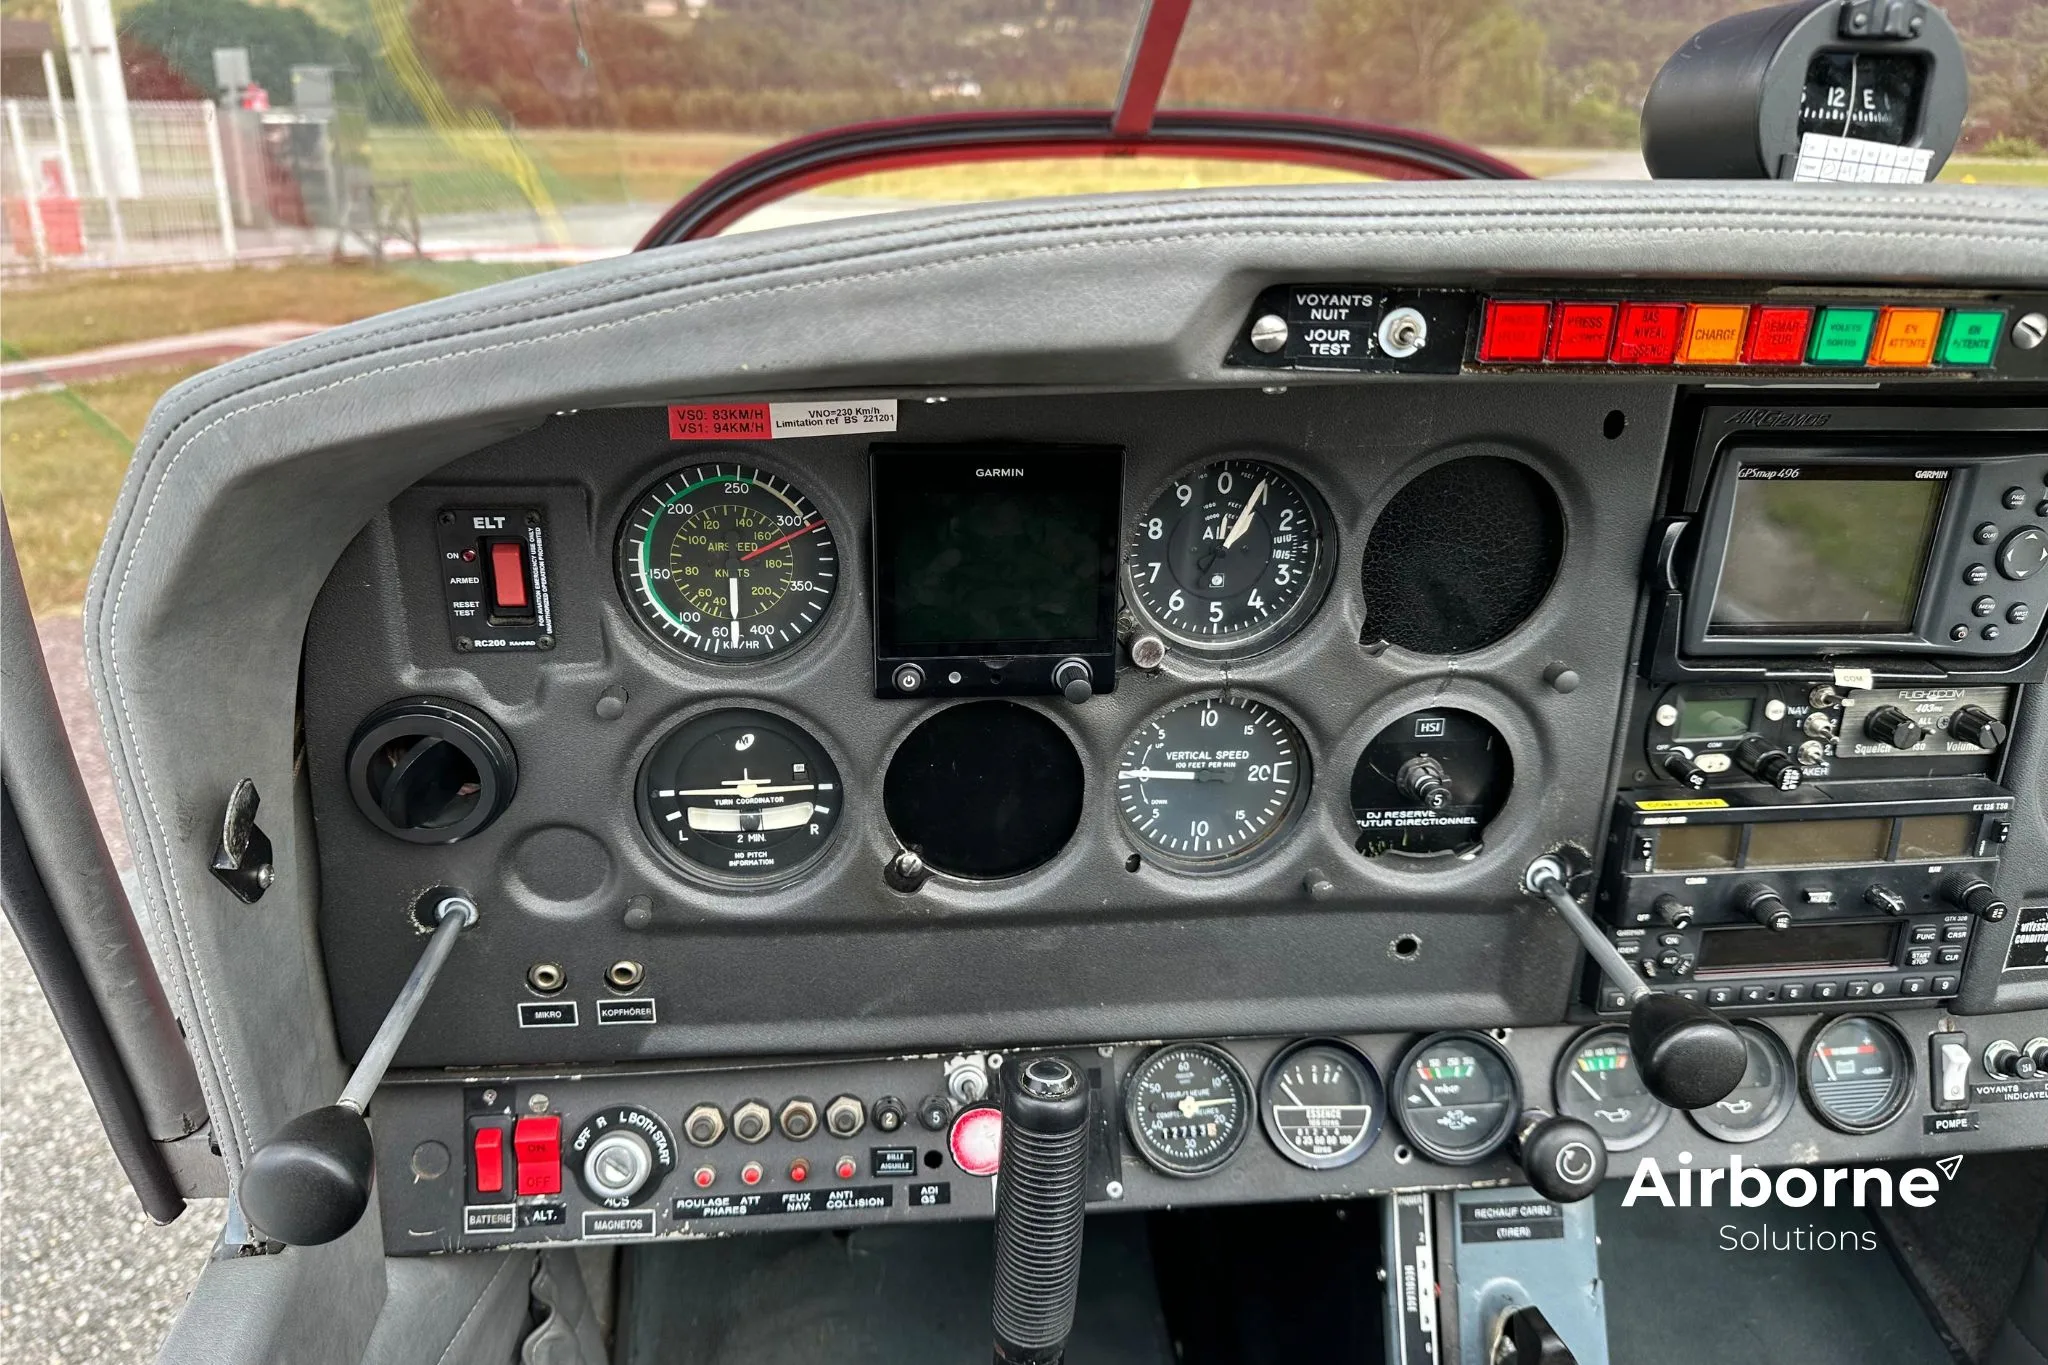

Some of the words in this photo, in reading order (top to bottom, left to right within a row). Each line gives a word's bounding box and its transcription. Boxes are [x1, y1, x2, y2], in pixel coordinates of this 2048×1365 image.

[1827, 87, 1846, 107] 12
[1863, 89, 1875, 109] E
[1296, 294, 1373, 307] VOYANTS
[1310, 309, 1350, 321] NUIT
[1304, 329, 1350, 342] JOUR
[1695, 328, 1736, 341] CHARGE
[1309, 343, 1351, 356] TEST
[712, 408, 764, 420] 83KM/H
[808, 408, 853, 419] VNO=230
[855, 406, 880, 416] Km/h
[775, 417, 823, 429] Limitation
[825, 416, 839, 426] ref
[844, 415, 858, 425] BS
[863, 413, 895, 424] 221201
[713, 421, 764, 433] 94KM/H
[975, 468, 1024, 477] GARMIN
[1738, 467, 1776, 480] GPSmap
[1777, 468, 1800, 478] 496
[1915, 470, 1949, 479] GARMIN
[724, 483, 749, 494] 250
[1217, 471, 1233, 495] 0
[1176, 484, 1193, 507] 9
[667, 503, 693, 515] 200
[1228, 501, 1243, 509] FEET
[473, 516, 505, 529] ELT
[703, 520, 720, 530] 120
[735, 518, 753, 528] 140
[776, 516, 802, 527] 300
[1279, 508, 1294, 532] 2
[1148, 518, 1163, 540] 8
[527, 527, 535, 543] ONLY
[688, 535, 707, 545] 100
[754, 532, 772, 541] 160
[529, 543, 537, 555] USE
[535, 527, 544, 561] PROHIBITED
[707, 542, 758, 552] AIRSEED
[446, 552, 459, 560] ON
[1272, 549, 1290, 560] 1015
[765, 559, 783, 569] 180
[531, 555, 541, 590] EMERGENCY
[538, 560, 548, 592] OPERATION
[649, 568, 671, 580] 150
[685, 567, 699, 576] 80
[714, 568, 750, 578] KNTS
[1148, 562, 1162, 584] 7
[1274, 563, 1290, 586] 3
[751, 586, 772, 596] 200
[790, 580, 813, 592] 350
[698, 588, 713, 598] 60
[1247, 588, 1264, 609] 4
[535, 590, 544, 615] AVIATION
[712, 597, 727, 606] 40
[1168, 589, 1185, 611] 6
[454, 609, 475, 617] TEST
[679, 612, 701, 623] 100
[1208, 601, 1224, 623] 5
[711, 626, 729, 637] 60
[750, 624, 775, 635] 400
[474, 639, 507, 647] RC200
[1843, 675, 1864, 683] COM
[1787, 706, 1809, 715] NAV
[1200, 709, 1219, 727] 10
[1918, 717, 1933, 725] ALL
[1243, 725, 1254, 735] 15
[1421, 722, 1440, 733] HSI
[1158, 729, 1166, 740] 5
[1854, 743, 1891, 755] Squelch
[1166, 751, 1212, 761] VERTICAL
[1215, 750, 1250, 760] SPEED
[1247, 765, 1271, 781] 20
[736, 796, 785, 805] COORDINATOR
[1152, 808, 1160, 818] 5
[1235, 810, 1246, 820] 15
[1384, 810, 1437, 819] RESERVE
[1395, 817, 1478, 826] DIRECTIONNEL
[810, 824, 819, 835] R
[1190, 820, 1210, 837] 10
[679, 830, 689, 841] L
[737, 835, 744, 843] 2
[748, 834, 767, 843] MIN.
[747, 851, 768, 859] PITCH
[729, 859, 775, 867] INFORMATION
[1665, 936, 1679, 945] ON
[1916, 933, 1936, 941] FUNC
[1947, 931, 1967, 939] CRSR
[1662, 956, 1678, 965] ALT
[1945, 954, 1959, 962] CLR
[1716, 992, 1726, 1001] 3
[535, 1010, 562, 1019] MIKRO
[1178, 1061, 1190, 1071] 60
[1149, 1082, 1161, 1093] 50
[1211, 1077, 1222, 1089] 10
[1976, 1084, 2019, 1095] VOYANTS
[596, 1116, 608, 1130] R
[619, 1112, 627, 1124] L
[628, 1112, 656, 1135] BOTH
[885, 1113, 893, 1125] 2
[1213, 1113, 1226, 1124] 20
[1935, 1118, 1968, 1129] POMPE
[1151, 1119, 1163, 1130] 40
[574, 1127, 593, 1151] OFF
[1184, 1138, 1197, 1149] 30
[527, 1144, 546, 1153] ON
[655, 1130, 671, 1166] START
[886, 1153, 904, 1161] BILLE
[880, 1162, 910, 1170] AIGUILLE
[526, 1177, 551, 1187] OFF
[828, 1190, 853, 1200] ANTI
[920, 1186, 939, 1196] ADI
[676, 1197, 730, 1209] ROULAGE
[739, 1195, 761, 1206] ATT
[782, 1192, 811, 1203] FEUX
[826, 1197, 885, 1209] COLLISION
[703, 1205, 747, 1217] PHARES
[787, 1202, 812, 1212] NAV.
[532, 1208, 558, 1222] ALT.
[1474, 1207, 1519, 1219] RECHAUF
[469, 1213, 512, 1225] BATTERIE
[594, 1219, 643, 1231] MAGNETOS
[1496, 1227, 1531, 1239] (TIRER)
